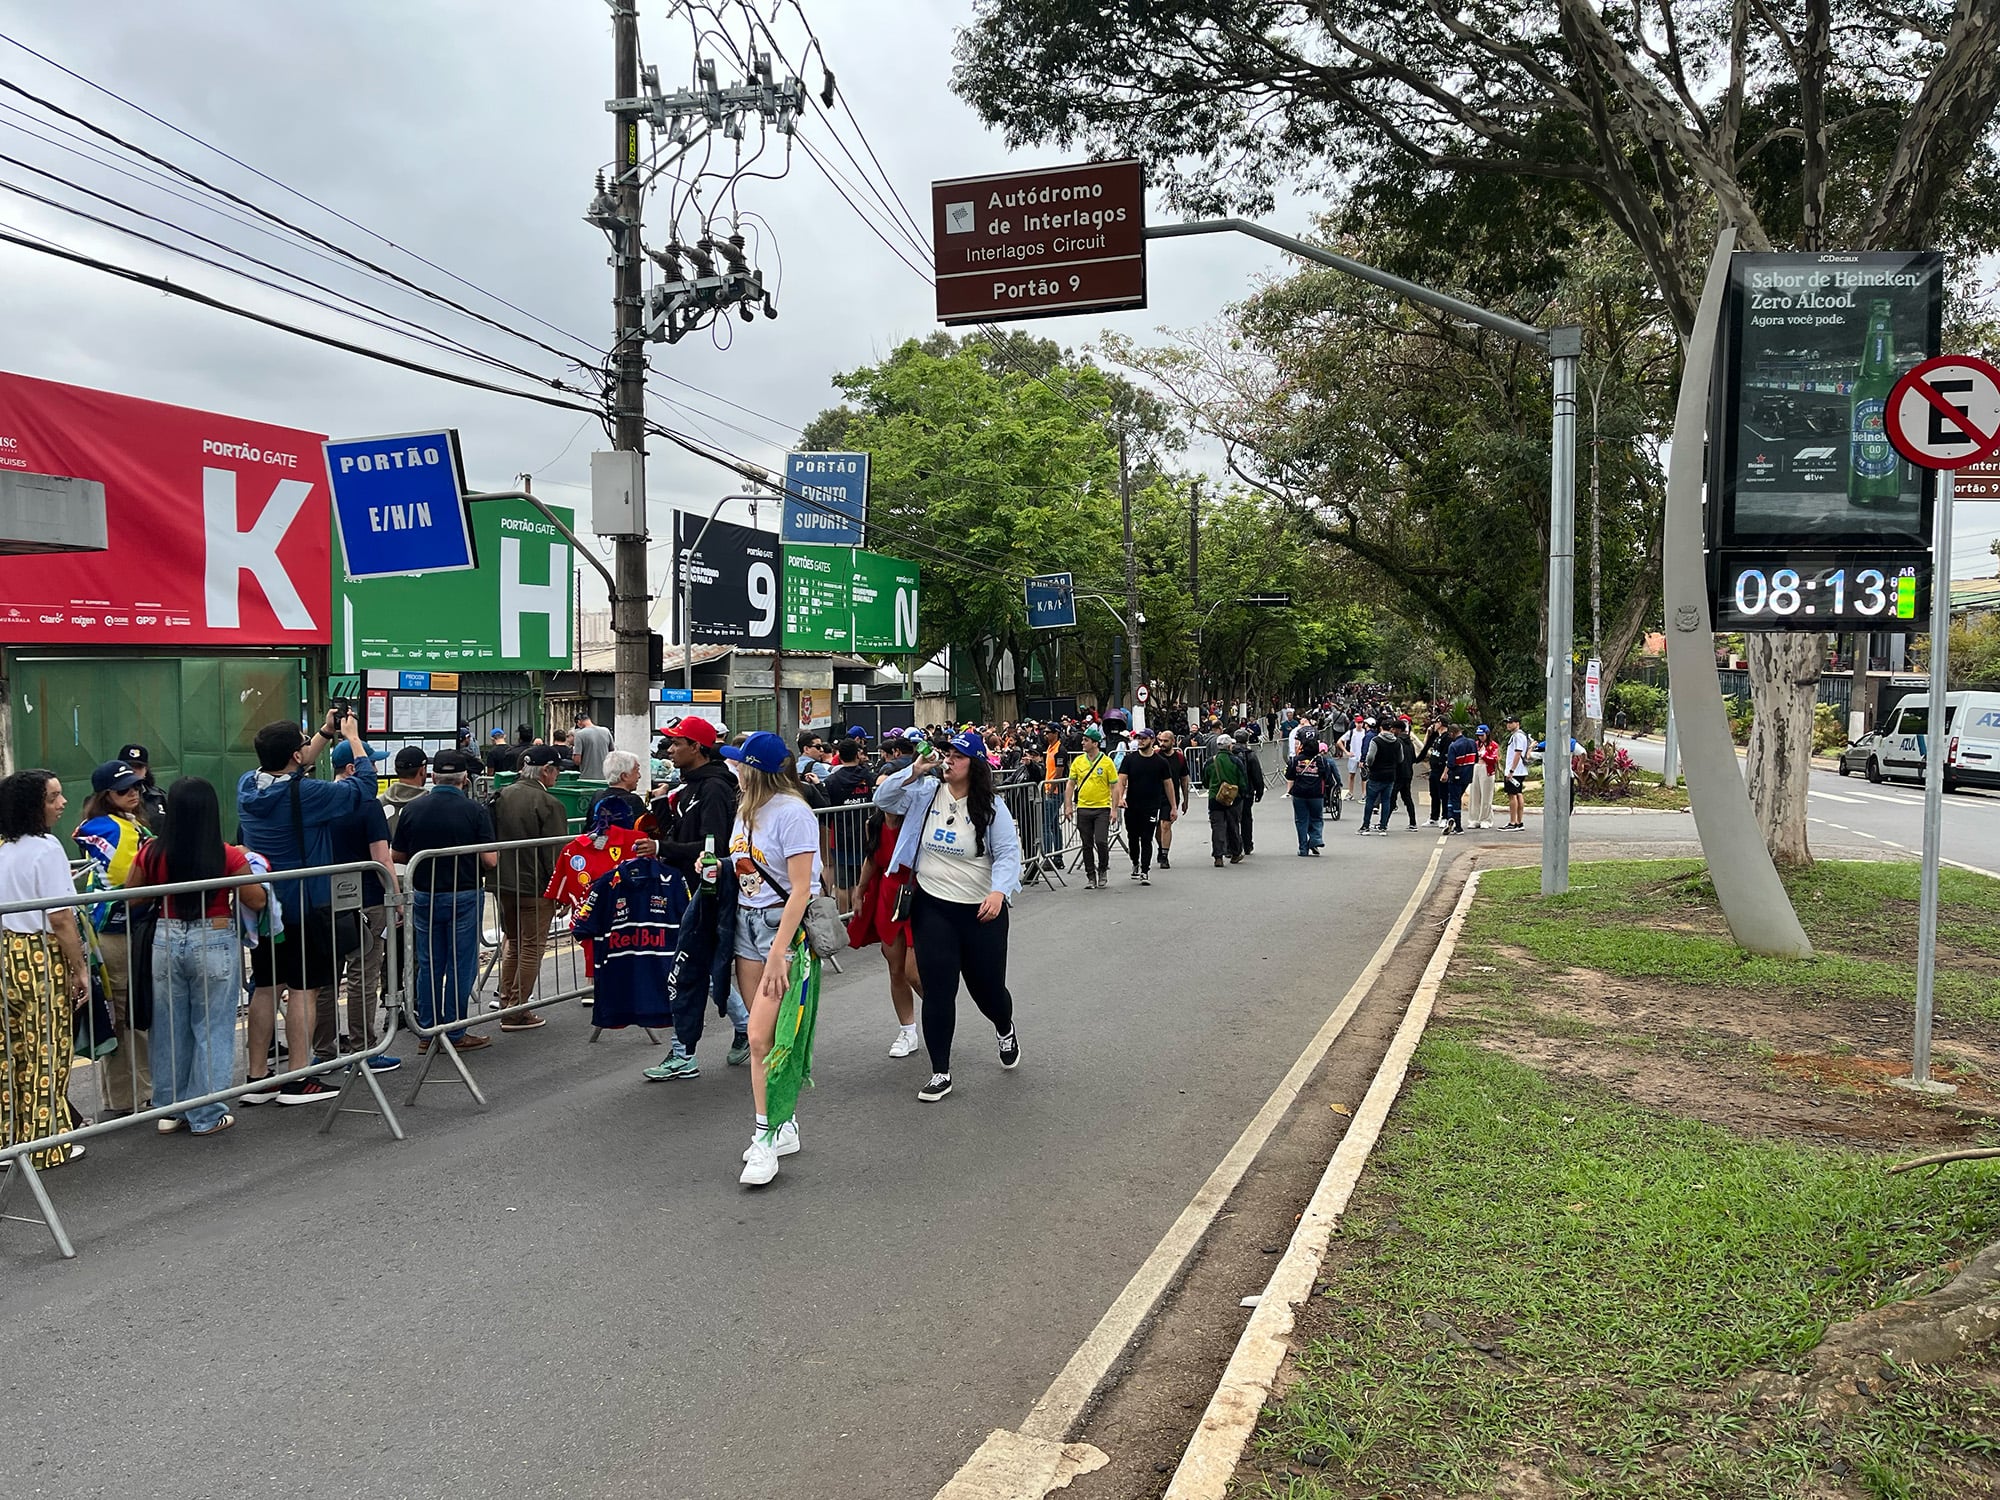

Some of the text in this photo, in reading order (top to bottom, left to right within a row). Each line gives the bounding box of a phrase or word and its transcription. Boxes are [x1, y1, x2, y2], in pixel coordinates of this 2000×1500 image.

[988, 183, 1103, 209] Autódromo
[988, 208, 1126, 235] de Interlagos
[966, 233, 1106, 262] Interlagos Circuit
[1818, 255, 1859, 263] JCDecaux
[993, 275, 1081, 300] Portão 9
[1752, 271, 1804, 288] Sabor
[1808, 271, 1830, 287] de
[1751, 290, 1857, 309] Zero Álcool.
[1751, 314, 1847, 327] Agora você pode.
[0, 437, 17, 449] SC
[0, 457, 27, 467] RUISES
[203, 439, 298, 468] PORTÃO GATE
[340, 447, 439, 473] PORTÃO
[795, 458, 857, 473] PORTÃO
[801, 485, 847, 502] EVENTO
[1954, 483, 1999, 493] ortão 9
[368, 502, 432, 532] E/H/N
[795, 512, 849, 530] SUPORTE
[501, 518, 556, 535] PORTÃO GATE
[203, 466, 318, 631] K
[746, 547, 774, 559] PORTÃO GATE
[788, 555, 831, 573] PORTÕES GATES
[1899, 566, 1915, 577] AR
[500, 536, 568, 658] H
[747, 561, 776, 637] 9
[1736, 569, 1886, 615] 08:13
[39, 613, 64, 624] Claro
[895, 587, 918, 648] N
[933, 828, 957, 844] 55
[609, 928, 666, 949] Red Bull
